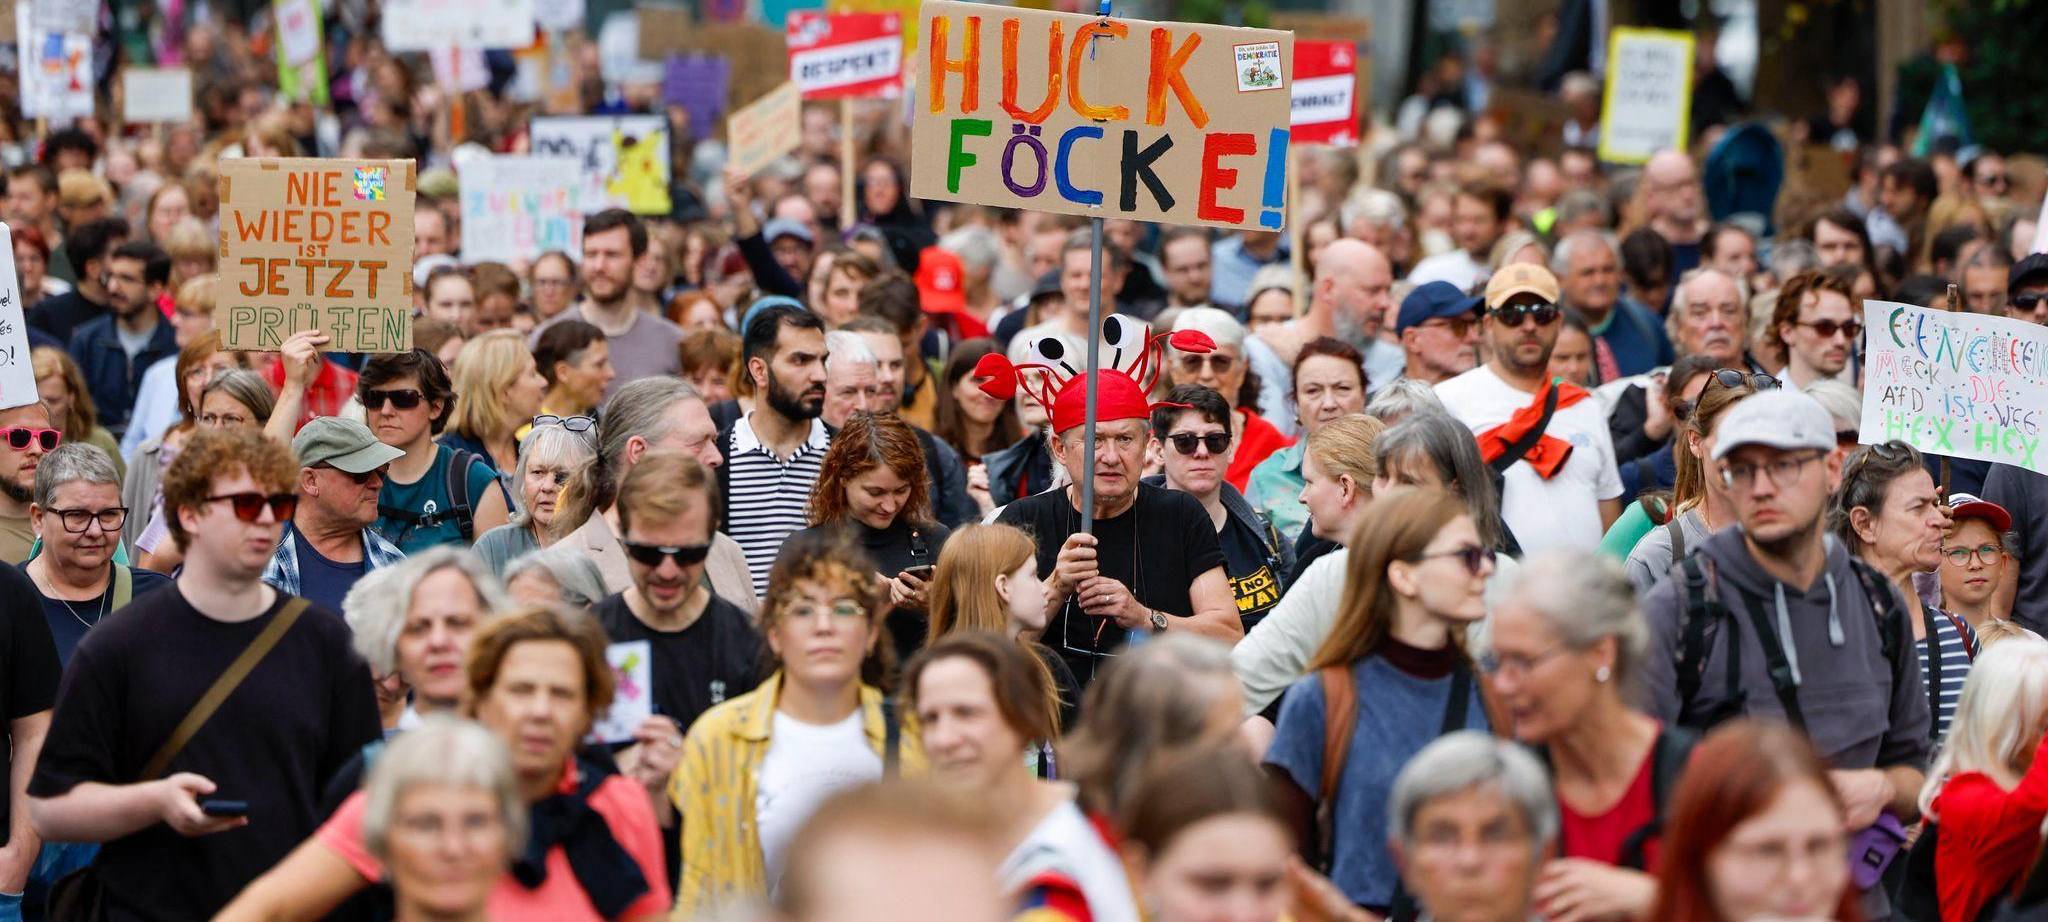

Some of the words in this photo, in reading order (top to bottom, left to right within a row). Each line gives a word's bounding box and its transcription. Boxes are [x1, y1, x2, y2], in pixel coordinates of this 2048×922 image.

[802, 48, 890, 79] RESPEKT
[929, 15, 1210, 130] HUCK
[1237, 50, 1278, 61] DEMOKRATIE
[287, 171, 342, 207] NIE
[946, 118, 1290, 229] FÖCKE!
[234, 209, 391, 246] WIEDER
[298, 244, 329, 258] IST
[239, 257, 388, 299] JETZT
[1882, 385, 1924, 412] AfD
[1885, 409, 1955, 451] HEX
[1974, 422, 2040, 472] HEX
[1244, 577, 1264, 592] NO
